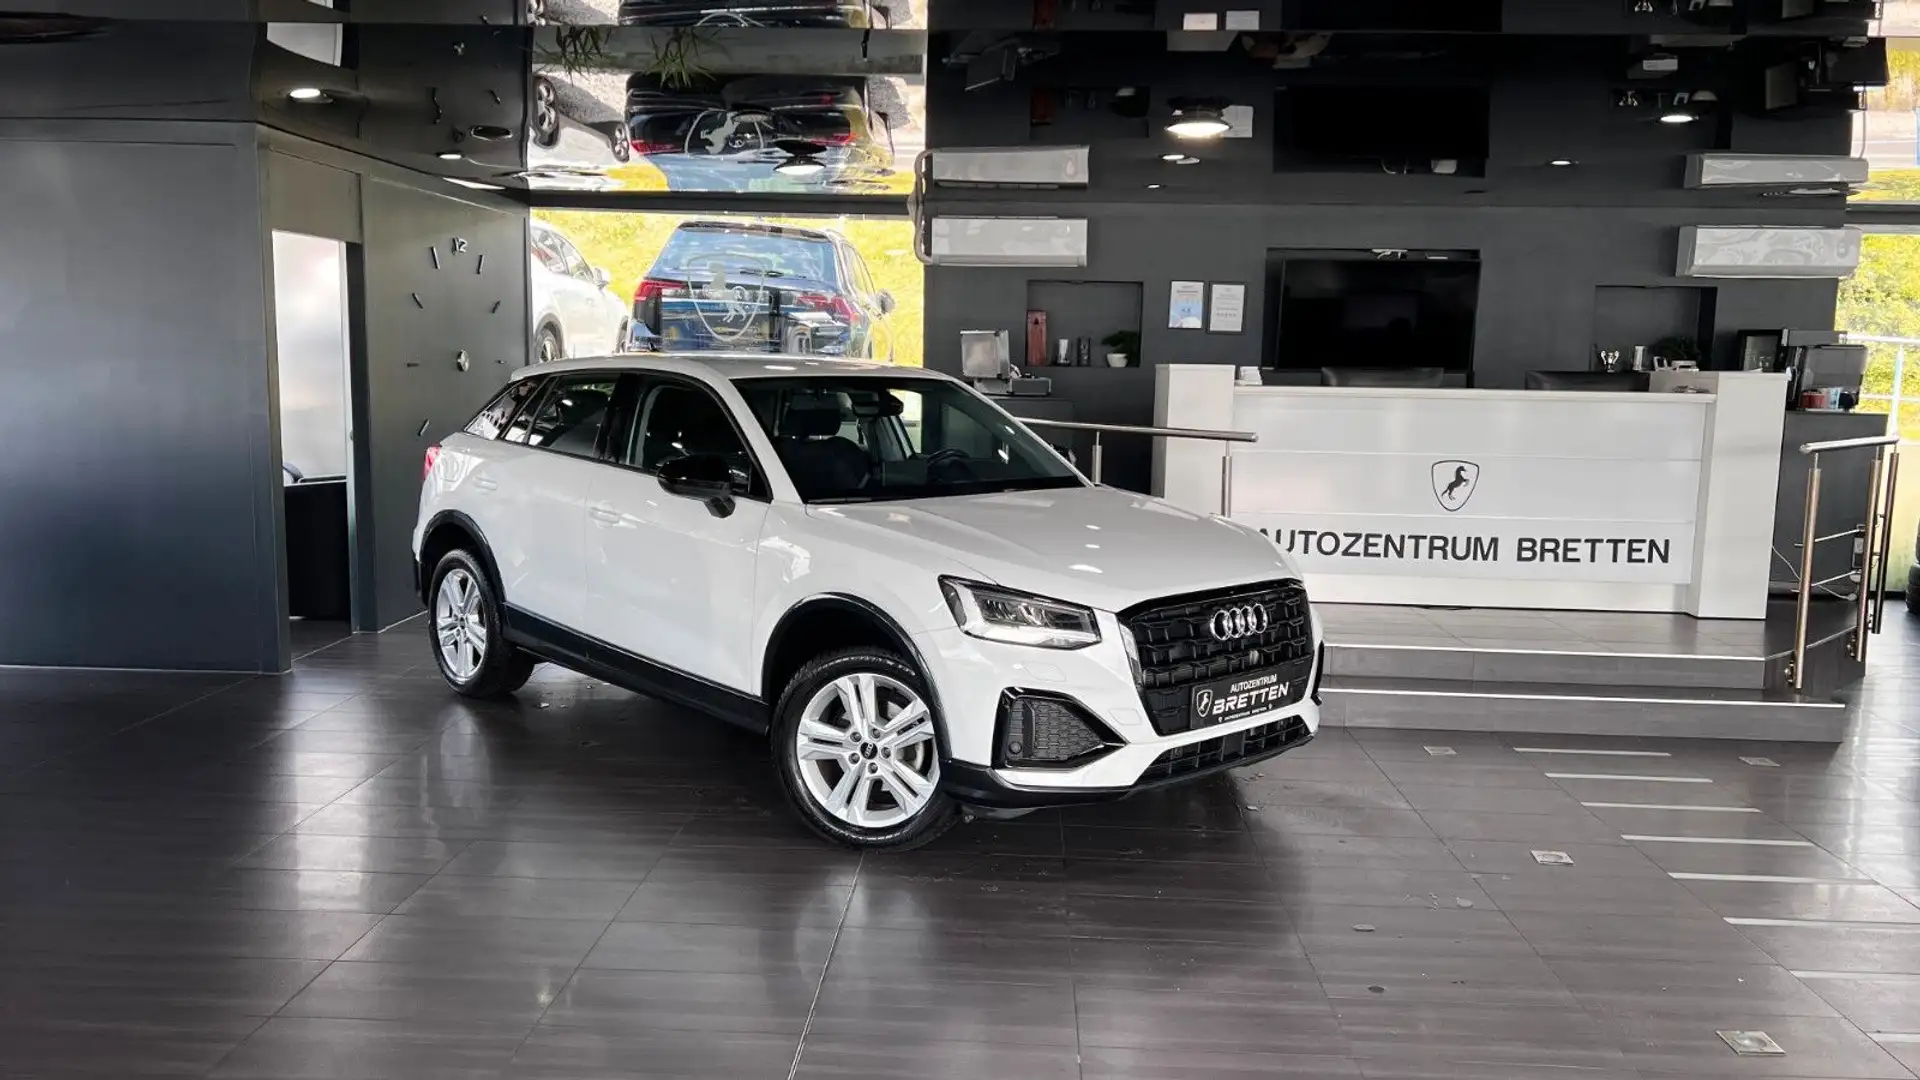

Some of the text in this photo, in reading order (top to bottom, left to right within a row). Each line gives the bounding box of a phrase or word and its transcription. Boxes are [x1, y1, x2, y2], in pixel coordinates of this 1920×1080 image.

[452, 237, 468, 254] 12
[1516, 537, 1670, 563] BRETTEN
[1230, 674, 1277, 693] AUTOZENTRUM
[1212, 681, 1290, 715] BRETTEN
